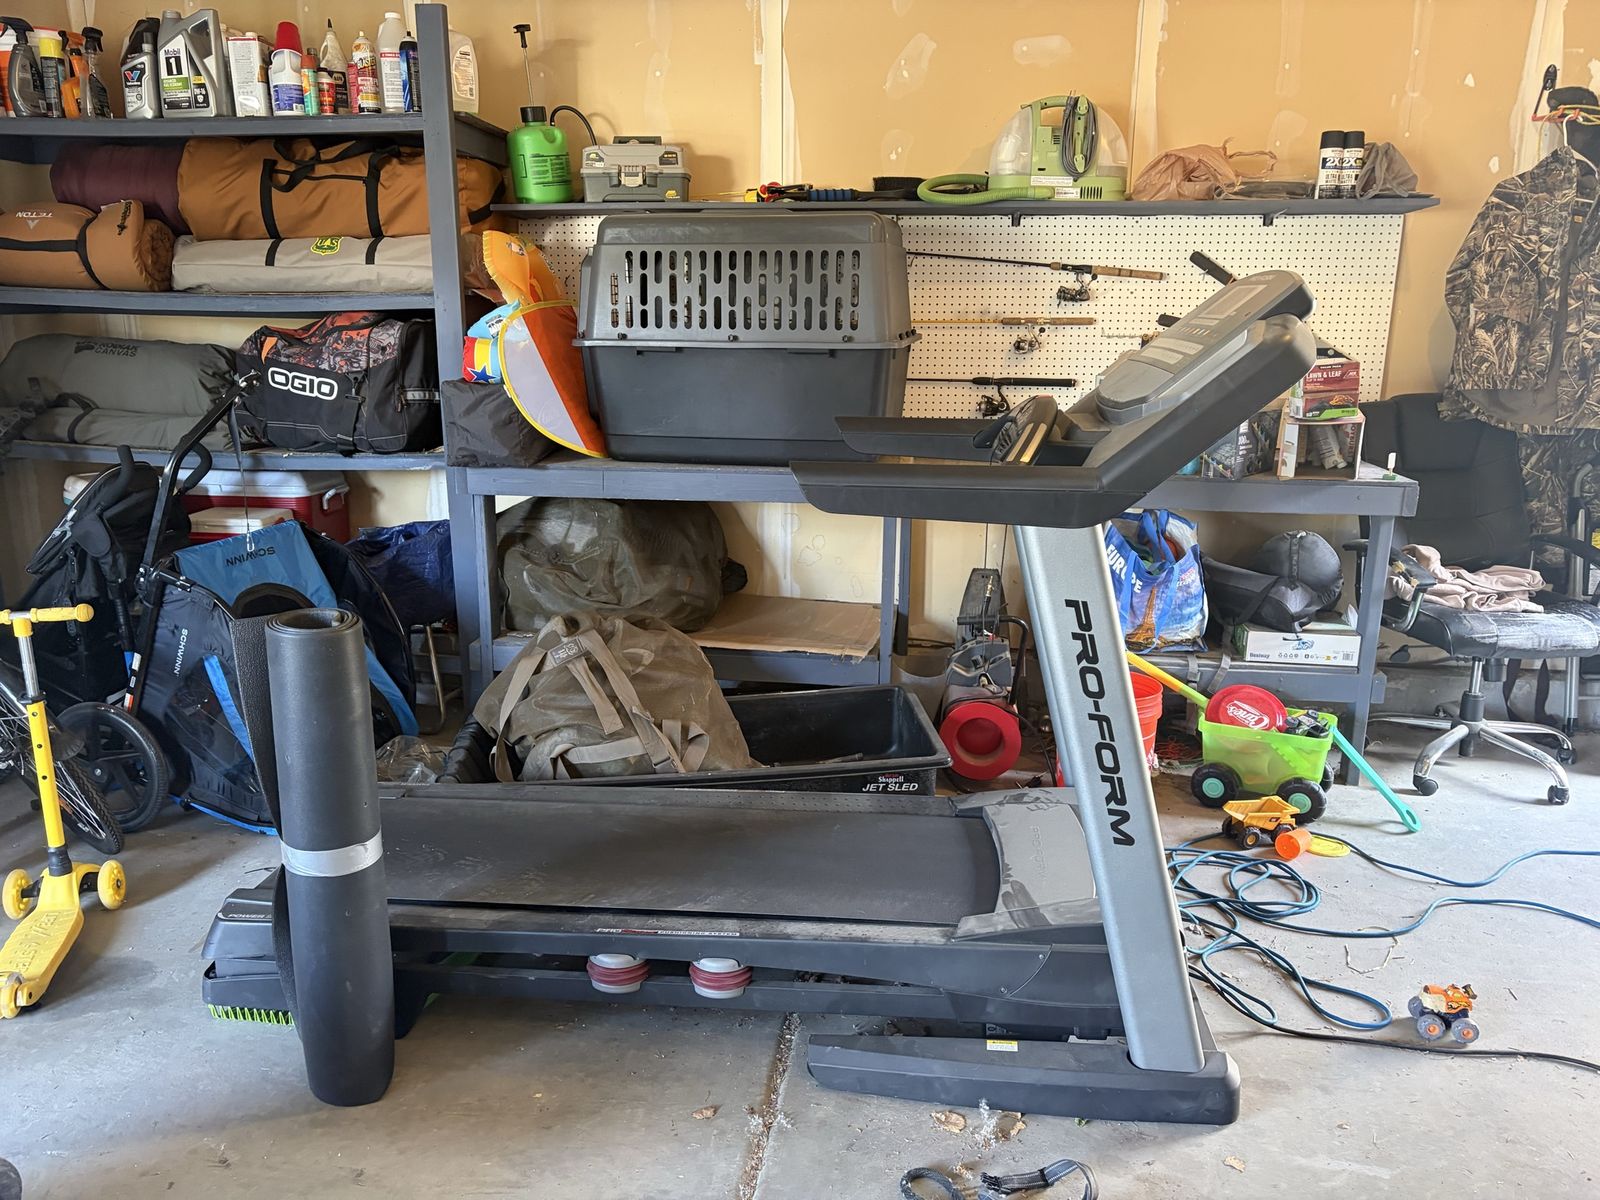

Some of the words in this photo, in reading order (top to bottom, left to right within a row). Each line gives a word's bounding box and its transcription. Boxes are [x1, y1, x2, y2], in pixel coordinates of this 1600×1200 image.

[164, 47, 181, 56] Mobil
[169, 57, 178, 75] 1
[1326, 157, 1341, 167] 2X
[1342, 157, 1357, 167] 2X
[95, 348, 137, 358] CANVAS
[1329, 370, 1342, 378] LEAF
[268, 367, 338, 401] OGIO
[173, 628, 188, 675] SCHWINN
[1249, 652, 1270, 660] Bestway
[1064, 598, 1136, 847] PRO-FORM
[862, 783, 885, 792] JET
[887, 783, 918, 791] SLED
